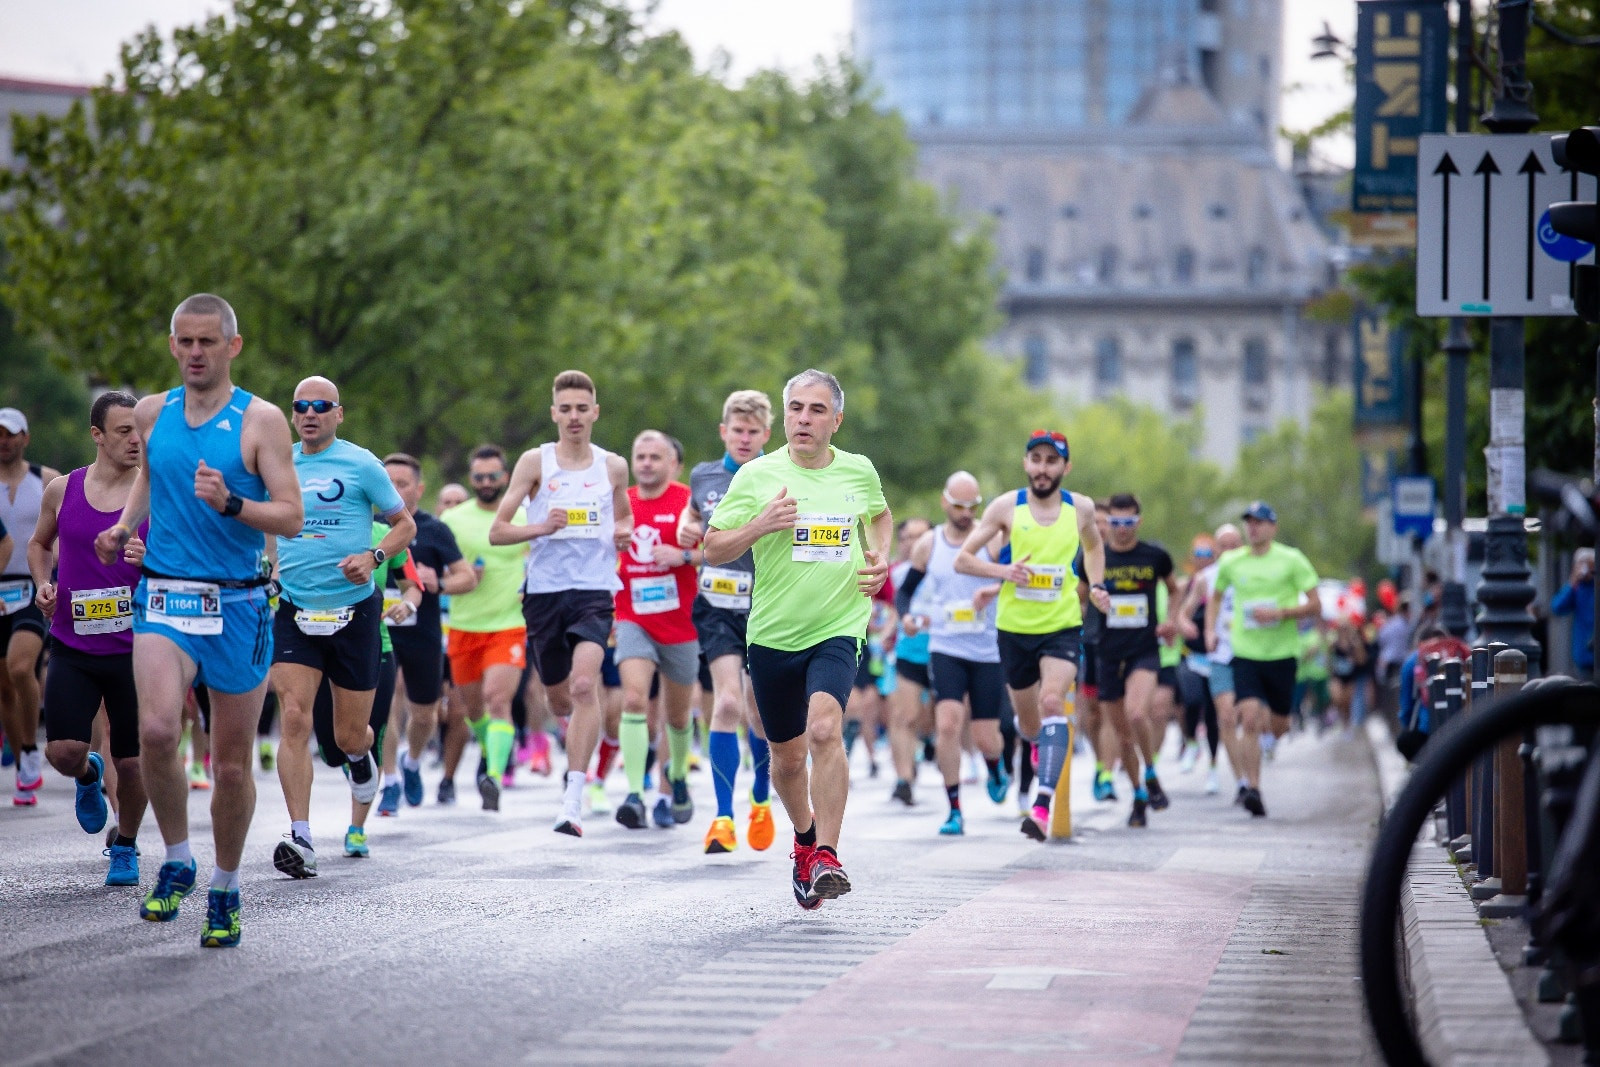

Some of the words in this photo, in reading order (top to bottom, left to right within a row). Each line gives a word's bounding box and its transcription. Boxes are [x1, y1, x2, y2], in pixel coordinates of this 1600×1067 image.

[303, 518, 341, 526] PPABLE
[566, 512, 587, 521] 030
[812, 529, 840, 541] 1784
[90, 602, 112, 614] 275
[169, 599, 198, 610] 11641
